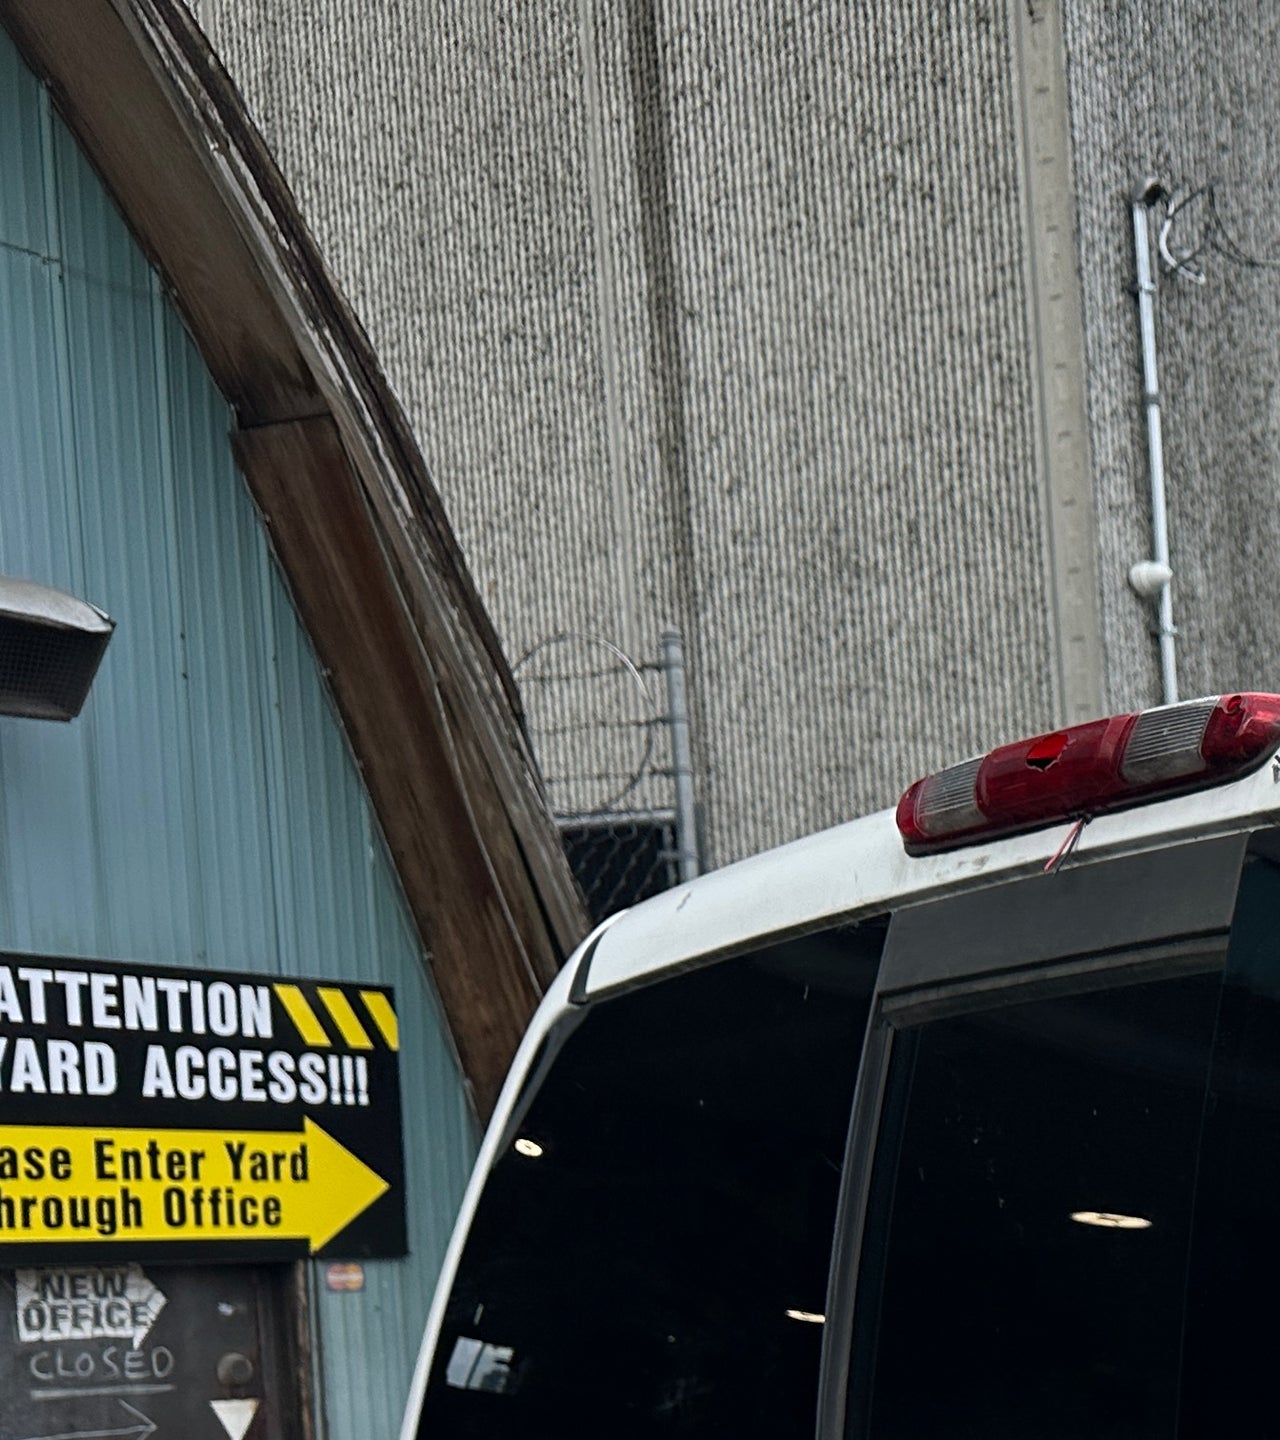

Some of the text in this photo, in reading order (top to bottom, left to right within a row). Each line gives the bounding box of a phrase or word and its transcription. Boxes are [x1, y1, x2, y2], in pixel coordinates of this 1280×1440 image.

[0, 964, 274, 1039] ATTENTION
[0, 1035, 370, 1106] ARD ACCESS!!!
[94, 1137, 206, 1181] Enter
[224, 1141, 309, 1181] Yard
[163, 1186, 283, 1227] Office
[40, 1274, 129, 1299] NEW
[23, 1300, 150, 1333] OFFICE
[30, 1345, 175, 1380] CLOSED
